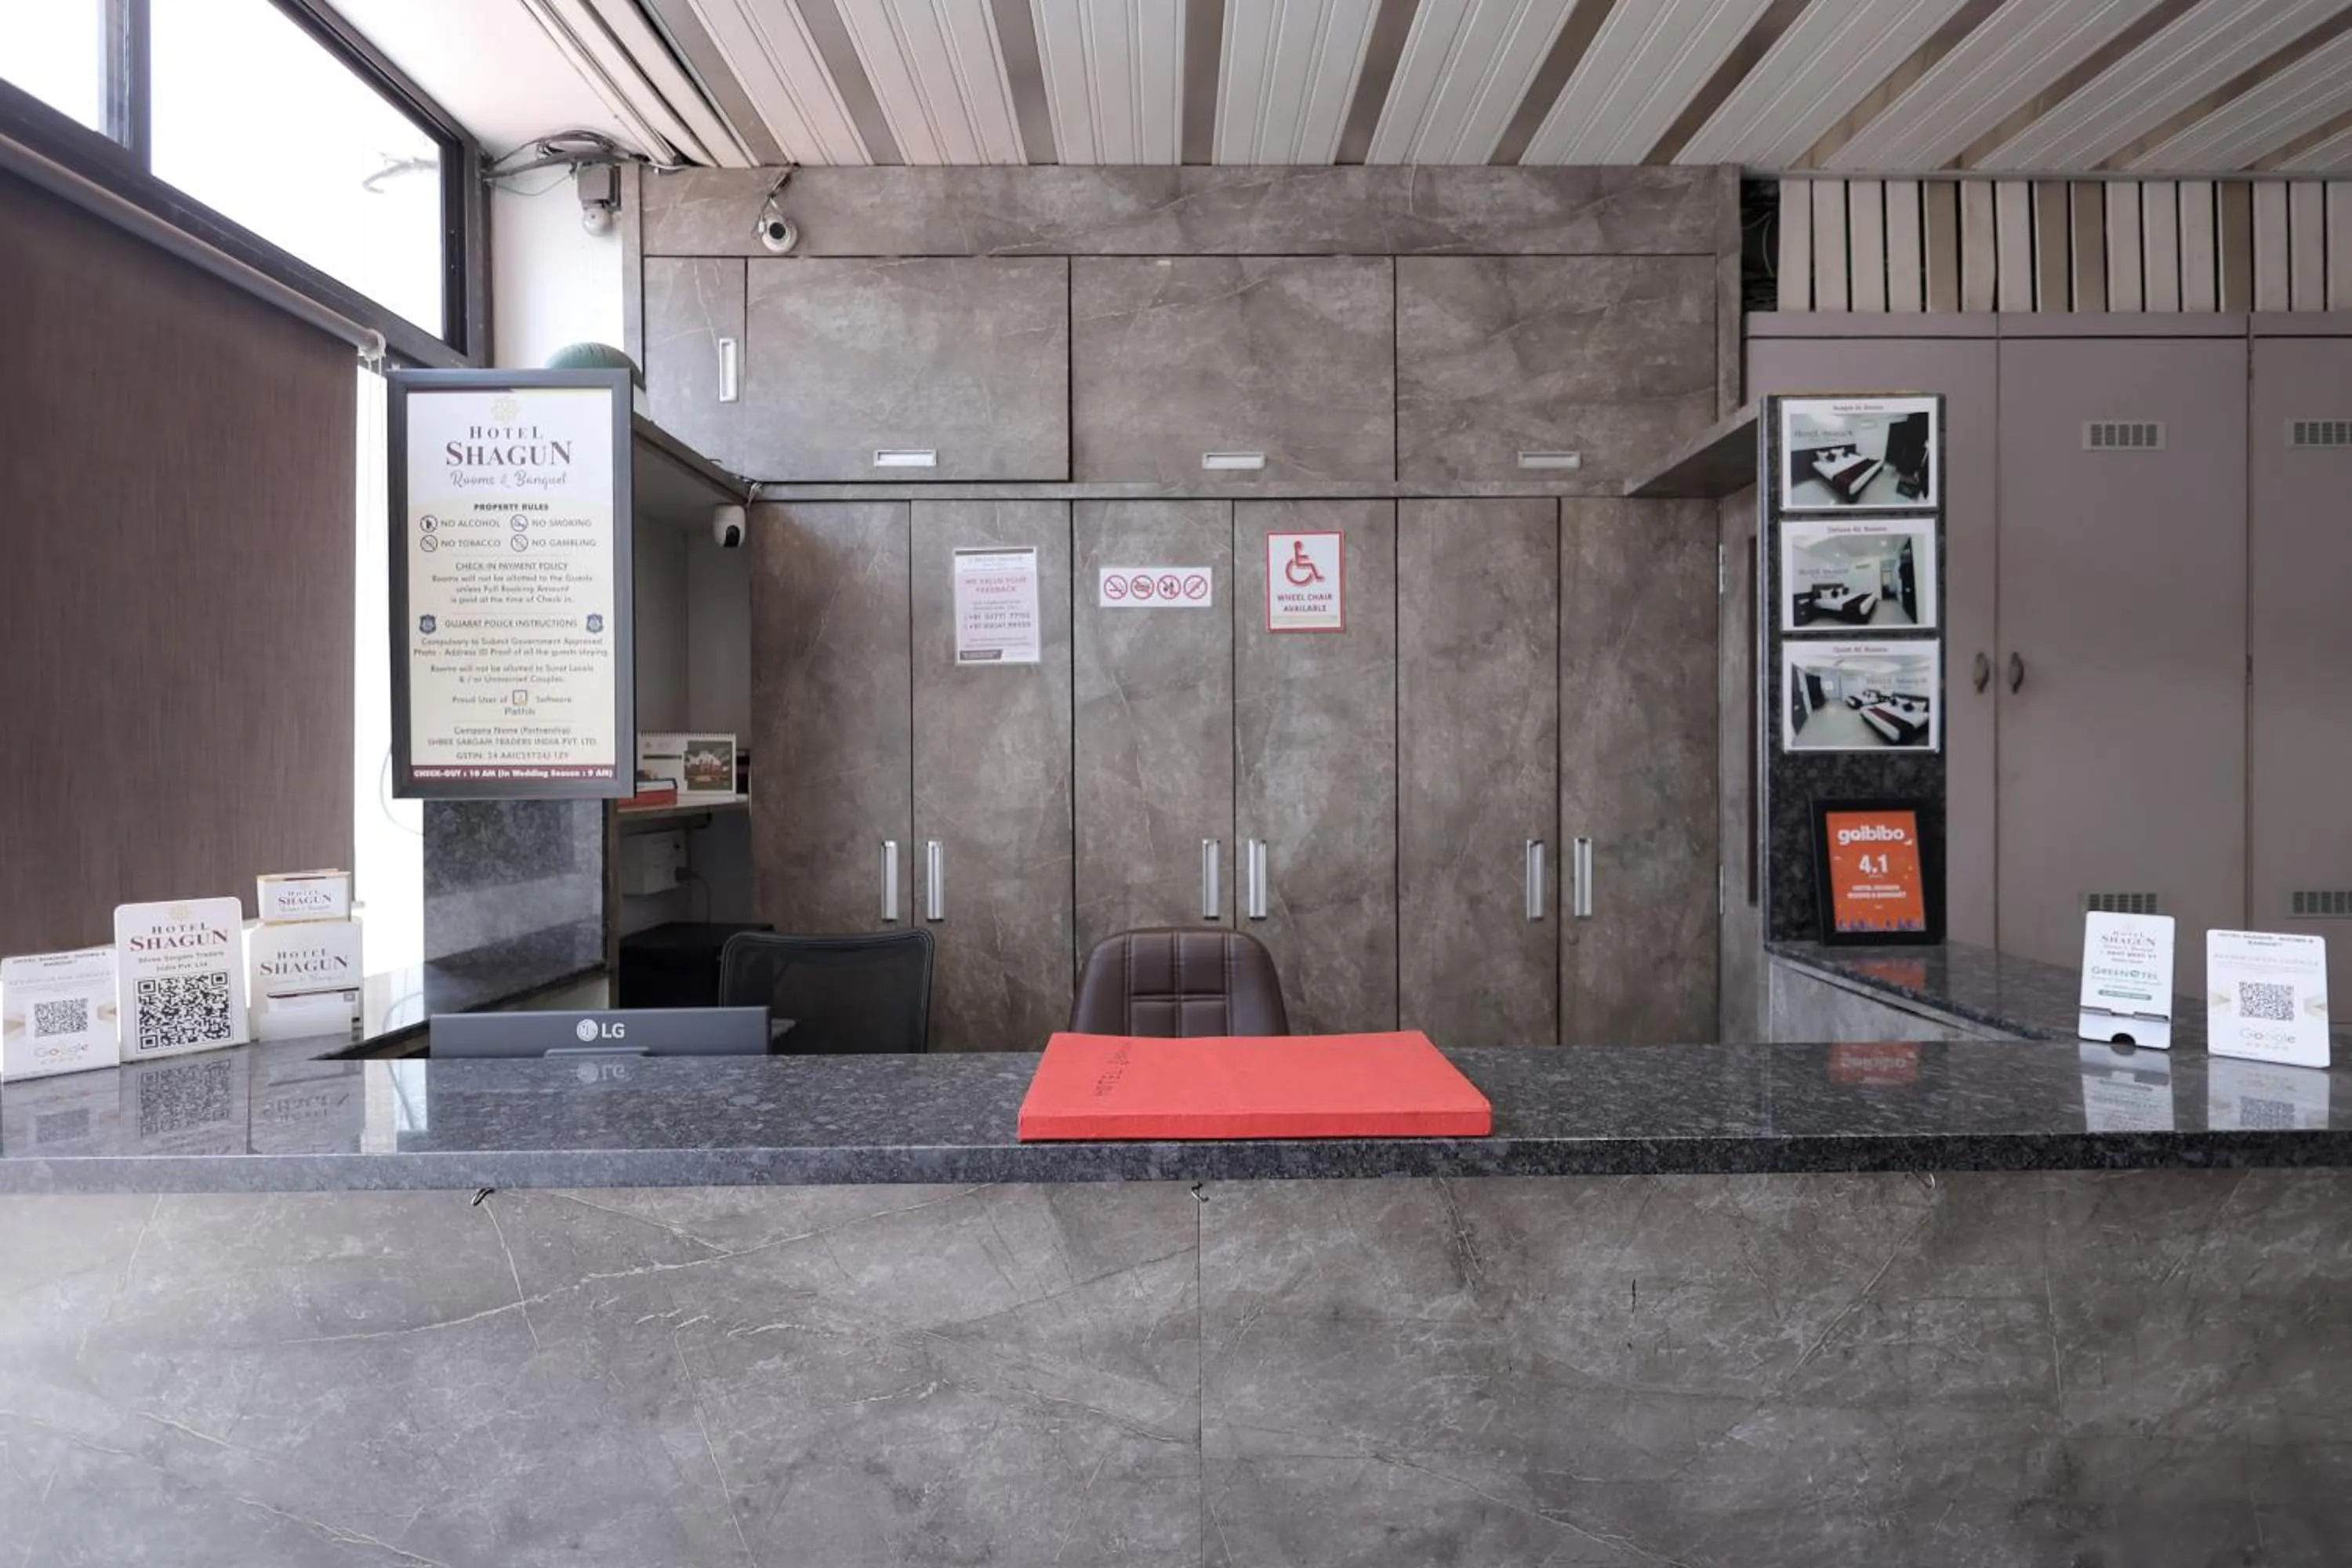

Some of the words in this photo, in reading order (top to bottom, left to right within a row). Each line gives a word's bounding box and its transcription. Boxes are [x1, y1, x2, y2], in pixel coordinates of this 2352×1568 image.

[470, 426, 544, 440] HOTEL
[445, 441, 572, 466] SHAGUN
[450, 470, 495, 488] Rooms
[514, 470, 567, 490] Banquet
[441, 519, 455, 528] NO
[458, 519, 500, 528] ALCOHOL
[441, 539, 455, 547] NO
[459, 539, 501, 547] TOBACCO
[532, 539, 546, 547] NO
[549, 539, 596, 547] GAMBLING
[499, 562, 535, 571] PAYMENT
[539, 562, 568, 571] POLICY
[1838, 826, 1904, 845] goibibo
[1859, 854, 1889, 873] 4.1
[278, 895, 332, 905] SHAGUN
[152, 922, 209, 934] HOTEL
[129, 928, 229, 952] SHAGUN
[277, 948, 326, 960] HOTEL
[260, 955, 348, 976] SHAGUN
[601, 1022, 625, 1039] LG
[2240, 1027, 2296, 1045] Google
